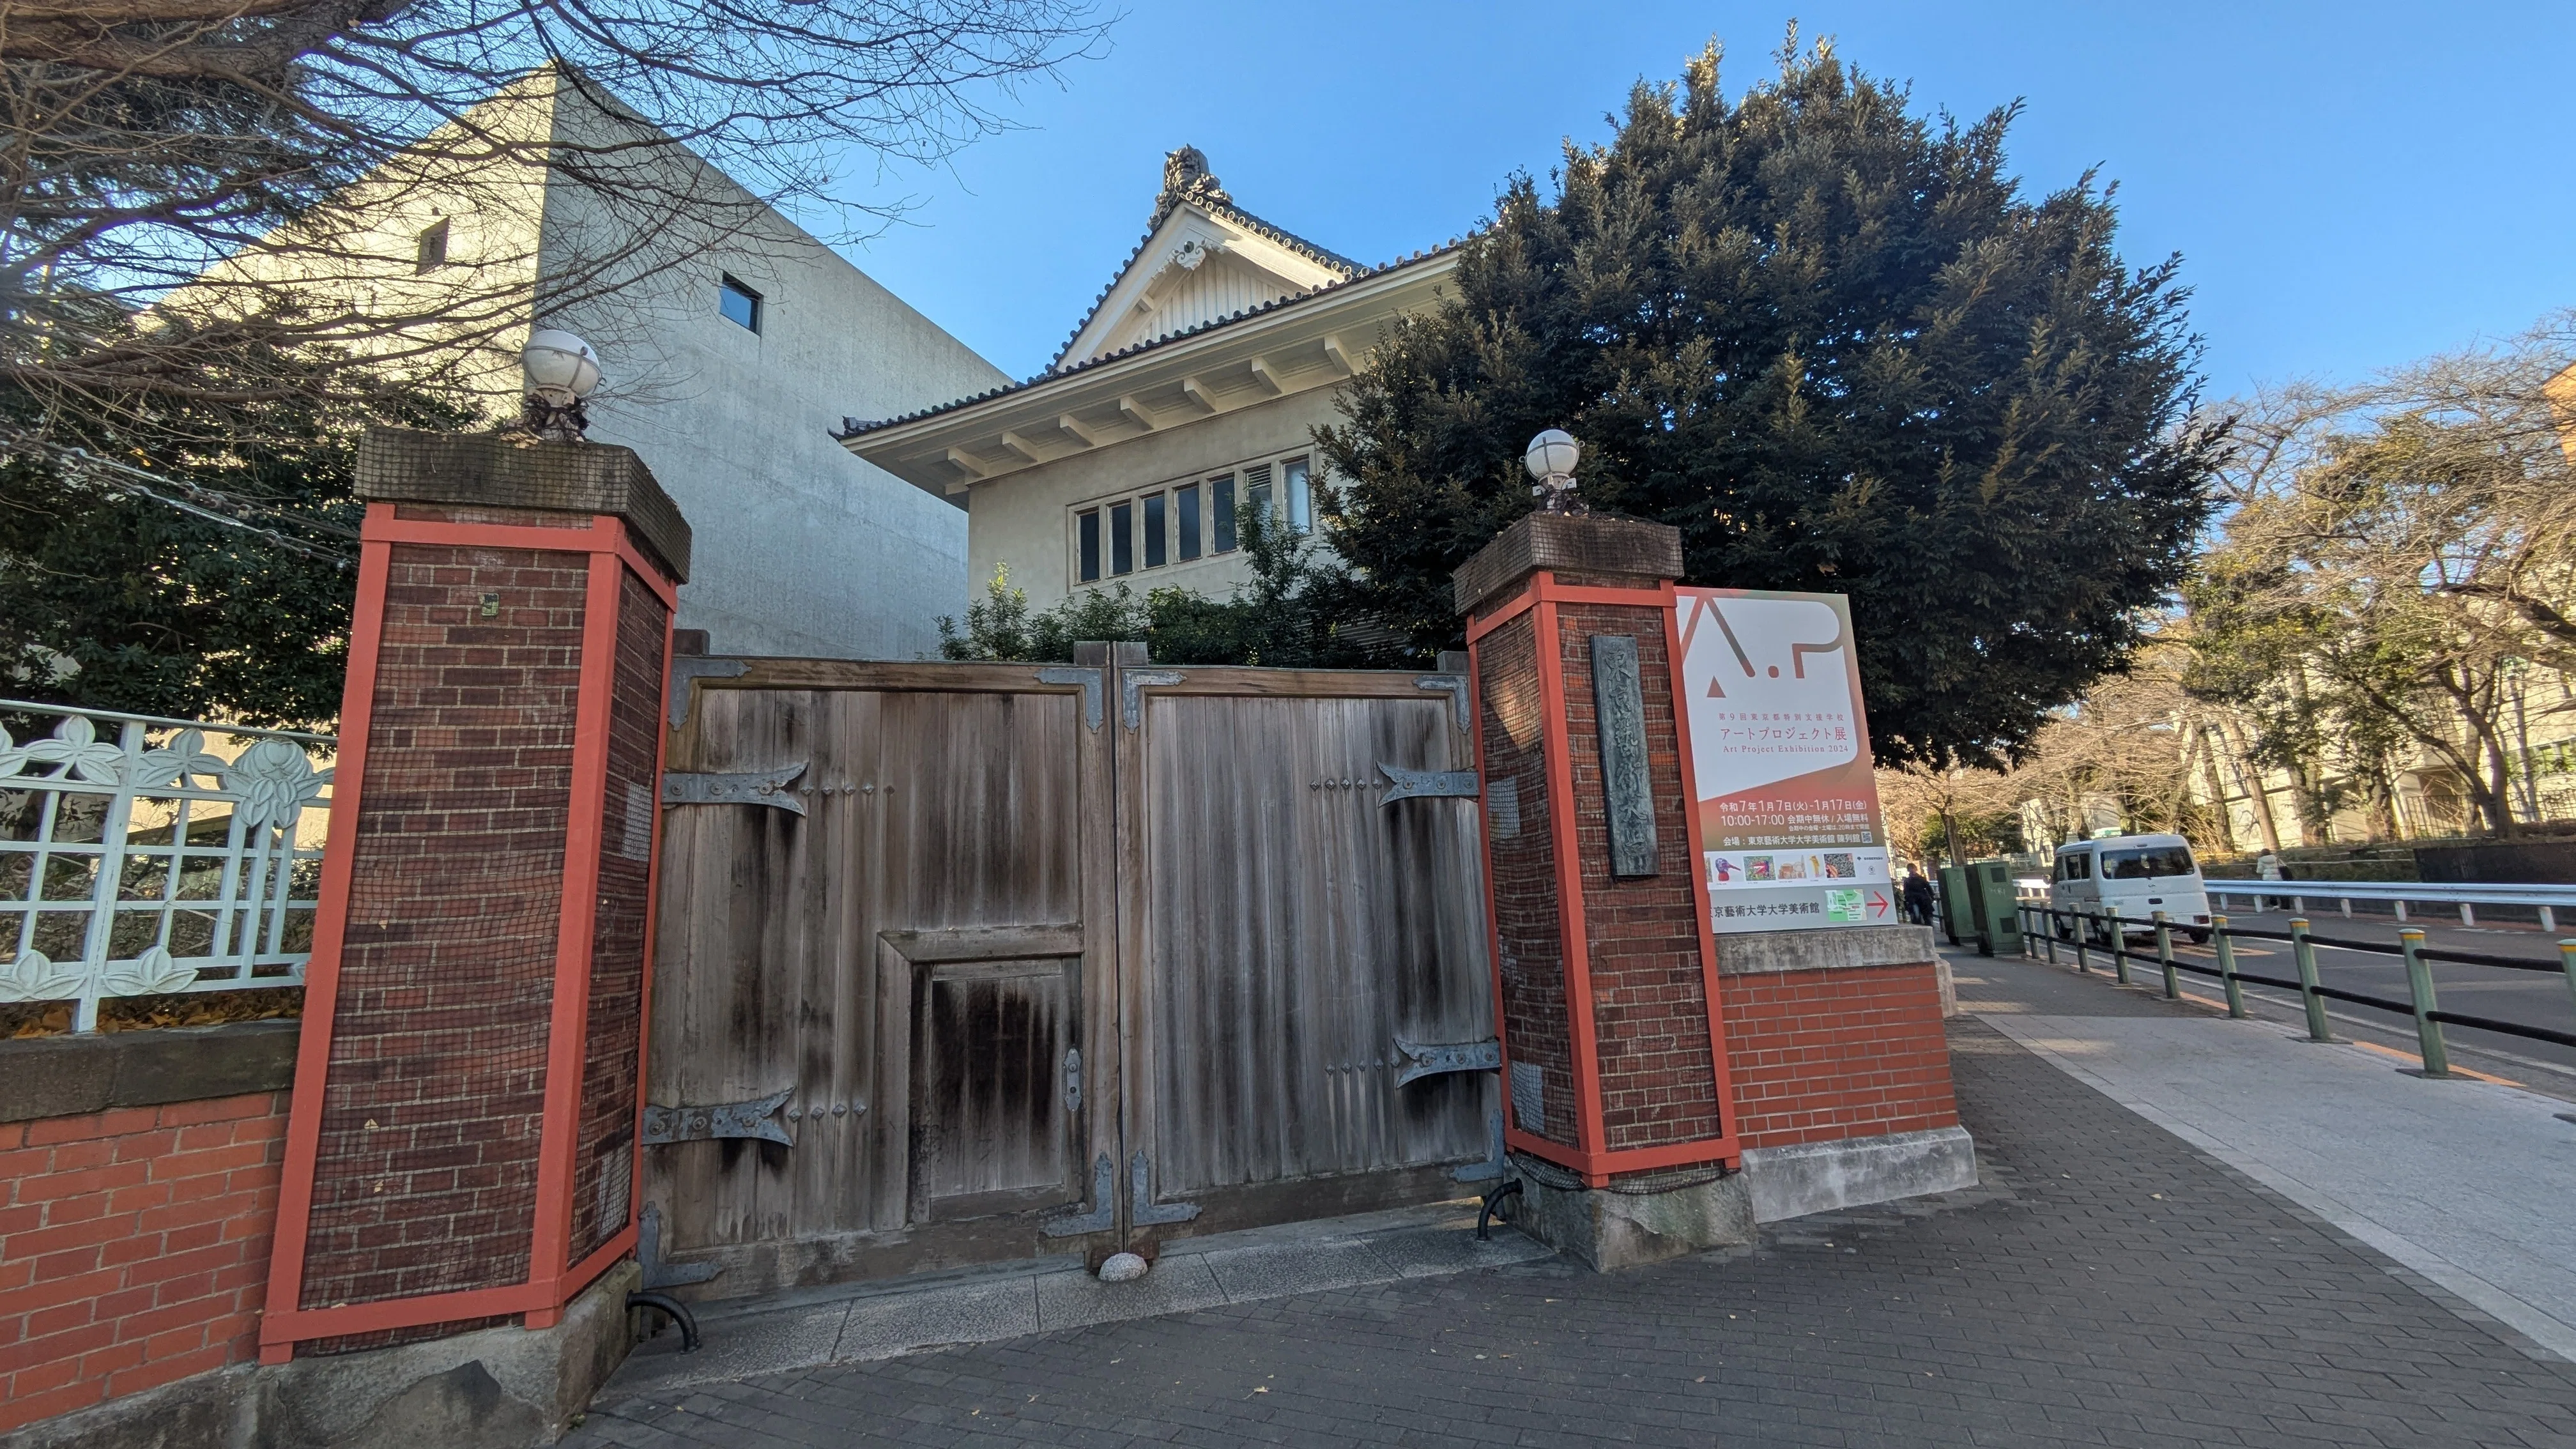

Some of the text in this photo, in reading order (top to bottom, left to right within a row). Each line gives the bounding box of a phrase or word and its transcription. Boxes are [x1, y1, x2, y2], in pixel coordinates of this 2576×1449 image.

[1720, 726, 1847, 740] アートプロジェクト展
[1742, 745, 1774, 754] Project
[1721, 814, 1784, 826] 10:00-17:00
[1710, 902, 1820, 919] 京藝術大学大学美術館
